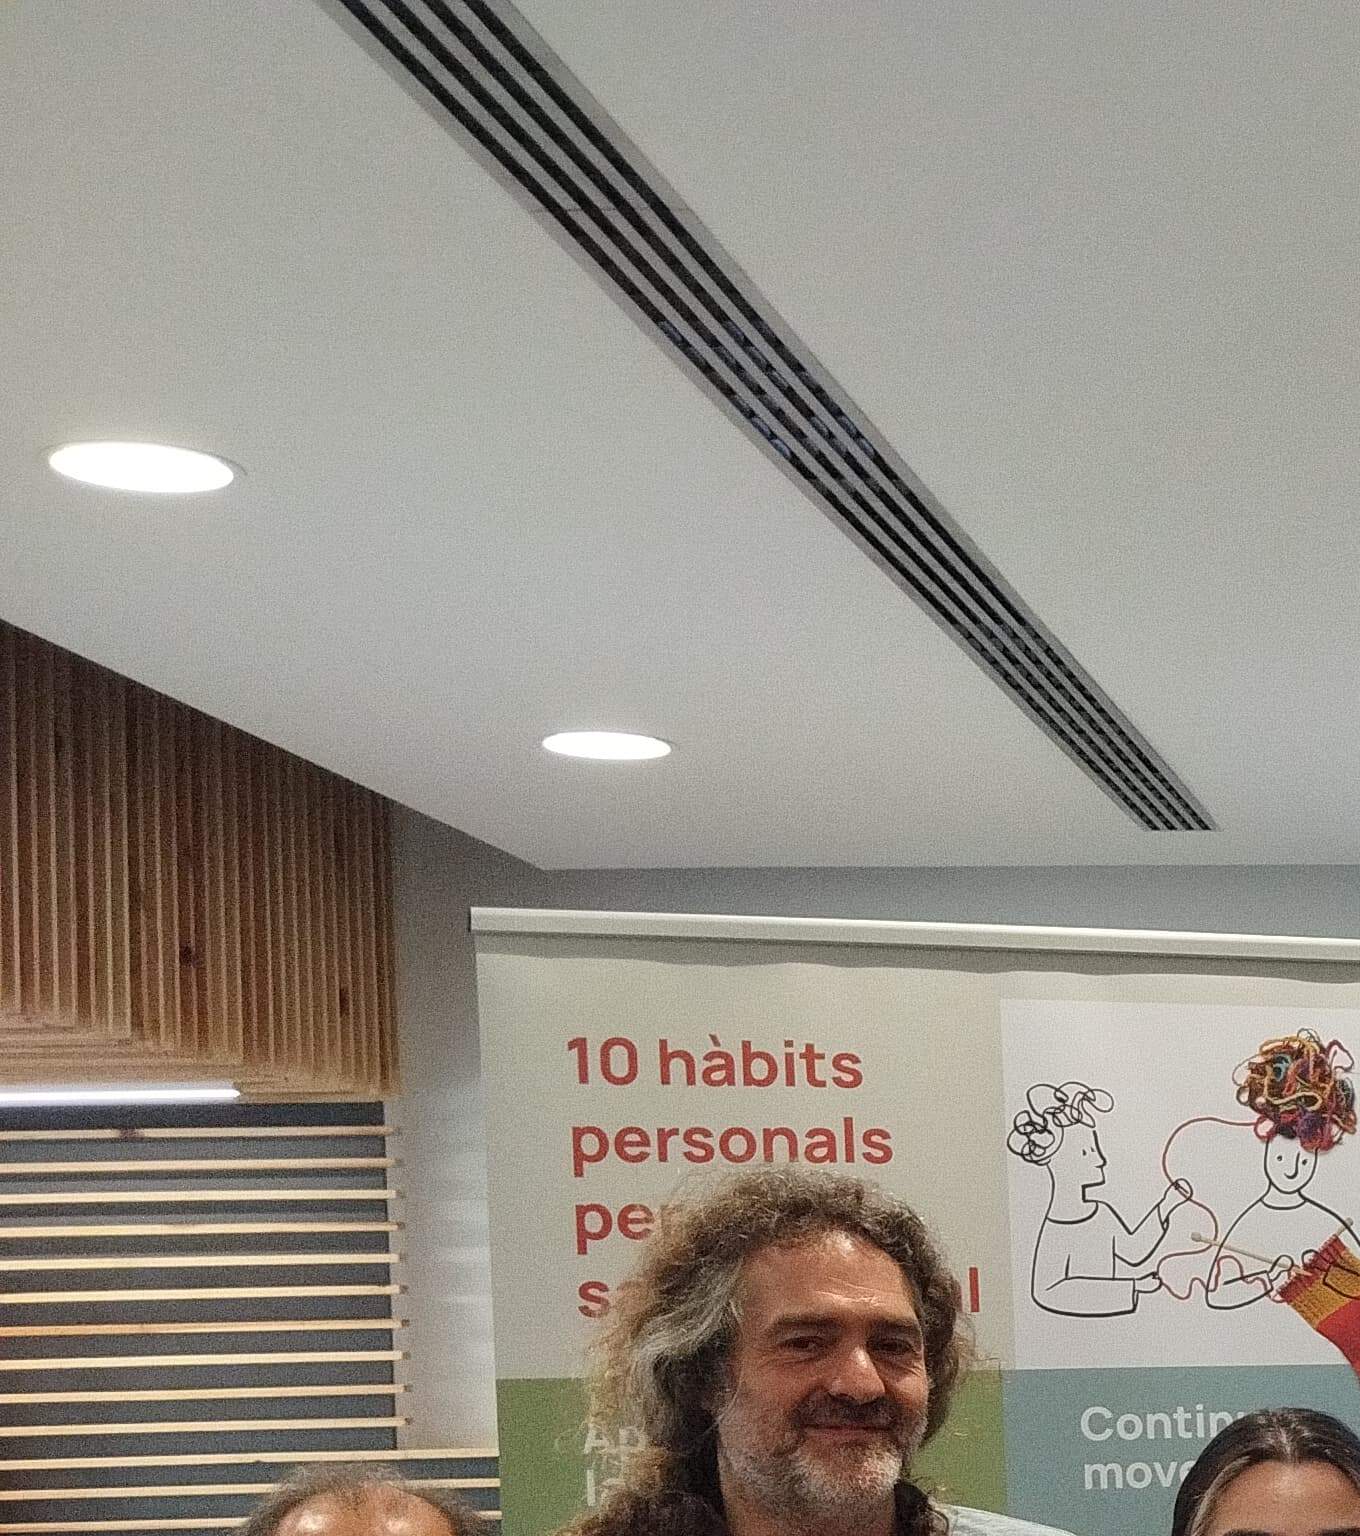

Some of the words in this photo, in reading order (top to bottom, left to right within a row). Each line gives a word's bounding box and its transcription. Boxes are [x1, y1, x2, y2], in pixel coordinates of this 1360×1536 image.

[567, 1036, 638, 1086] 10
[658, 1033, 864, 1089] hàbits
[571, 1116, 894, 1178] personals
[1081, 1404, 1246, 1441] Contin
